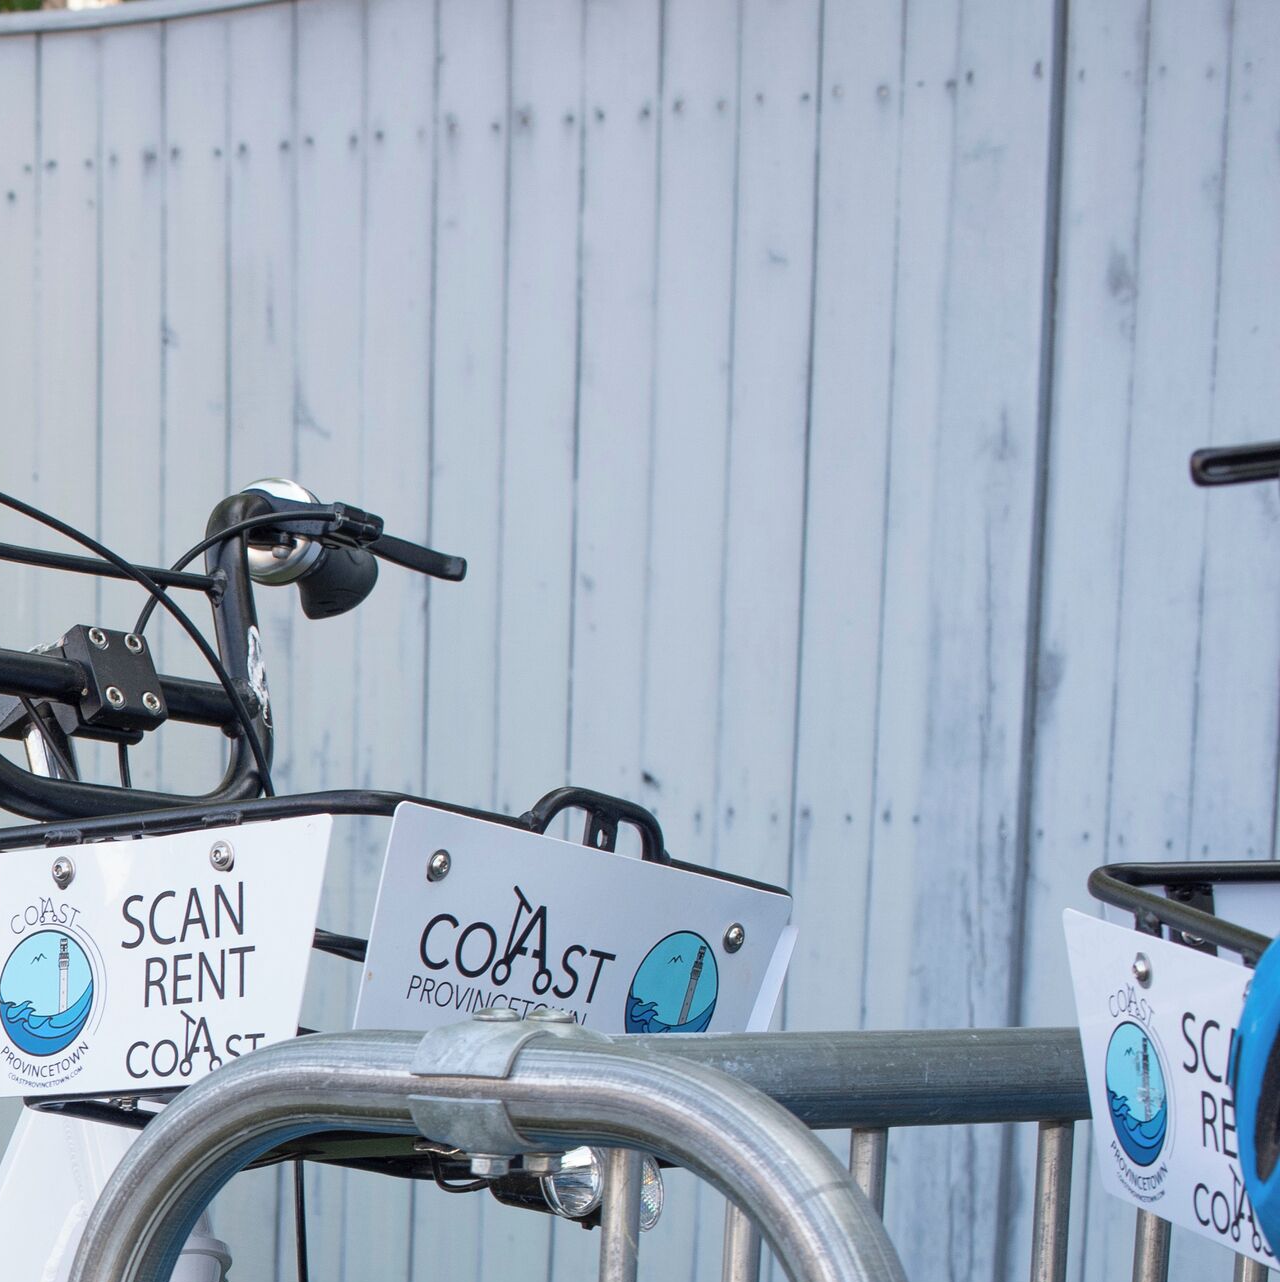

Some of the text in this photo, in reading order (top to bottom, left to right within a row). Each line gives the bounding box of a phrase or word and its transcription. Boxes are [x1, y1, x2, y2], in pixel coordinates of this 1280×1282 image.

[10, 897, 81, 935] COAST
[121, 881, 244, 949] SCAN
[420, 885, 617, 1004] COAST
[144, 945, 256, 1008] RENT
[1108, 982, 1156, 1026] COAST
[0, 1041, 89, 1078] PROVINCETOWN
[7, 1065, 84, 1088] COASTPROVINCETOWN.COM
[1201, 1091, 1237, 1159] RE
[1110, 1141, 1169, 1191] PROVINCETOWN
